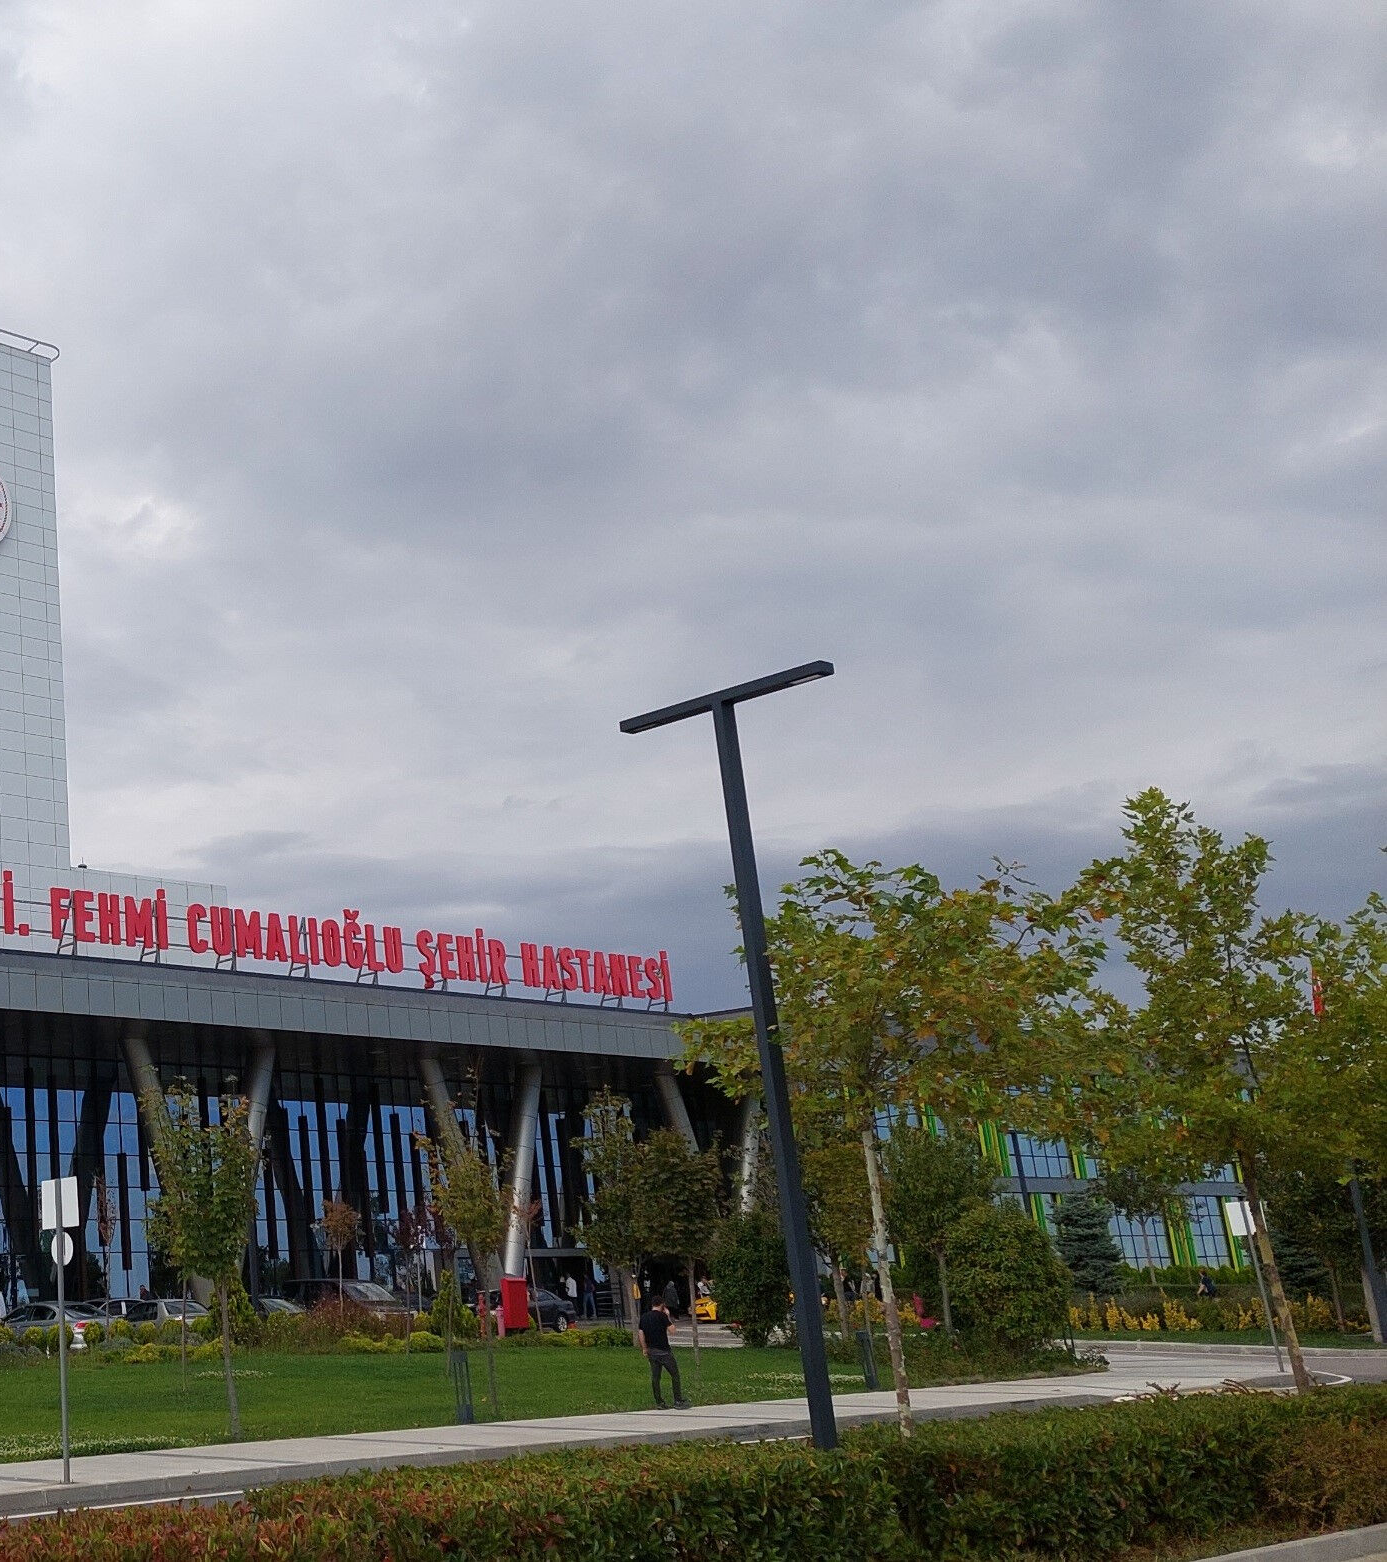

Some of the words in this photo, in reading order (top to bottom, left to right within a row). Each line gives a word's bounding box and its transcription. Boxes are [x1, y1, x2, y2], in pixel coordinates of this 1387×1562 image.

[3, 870, 30, 936] İ.
[50, 887, 169, 950] FEHMİ
[187, 903, 404, 973] CUMALIOĞLU
[416, 928, 509, 989] ŞEHİR
[520, 943, 673, 1002] HASTANESİ
